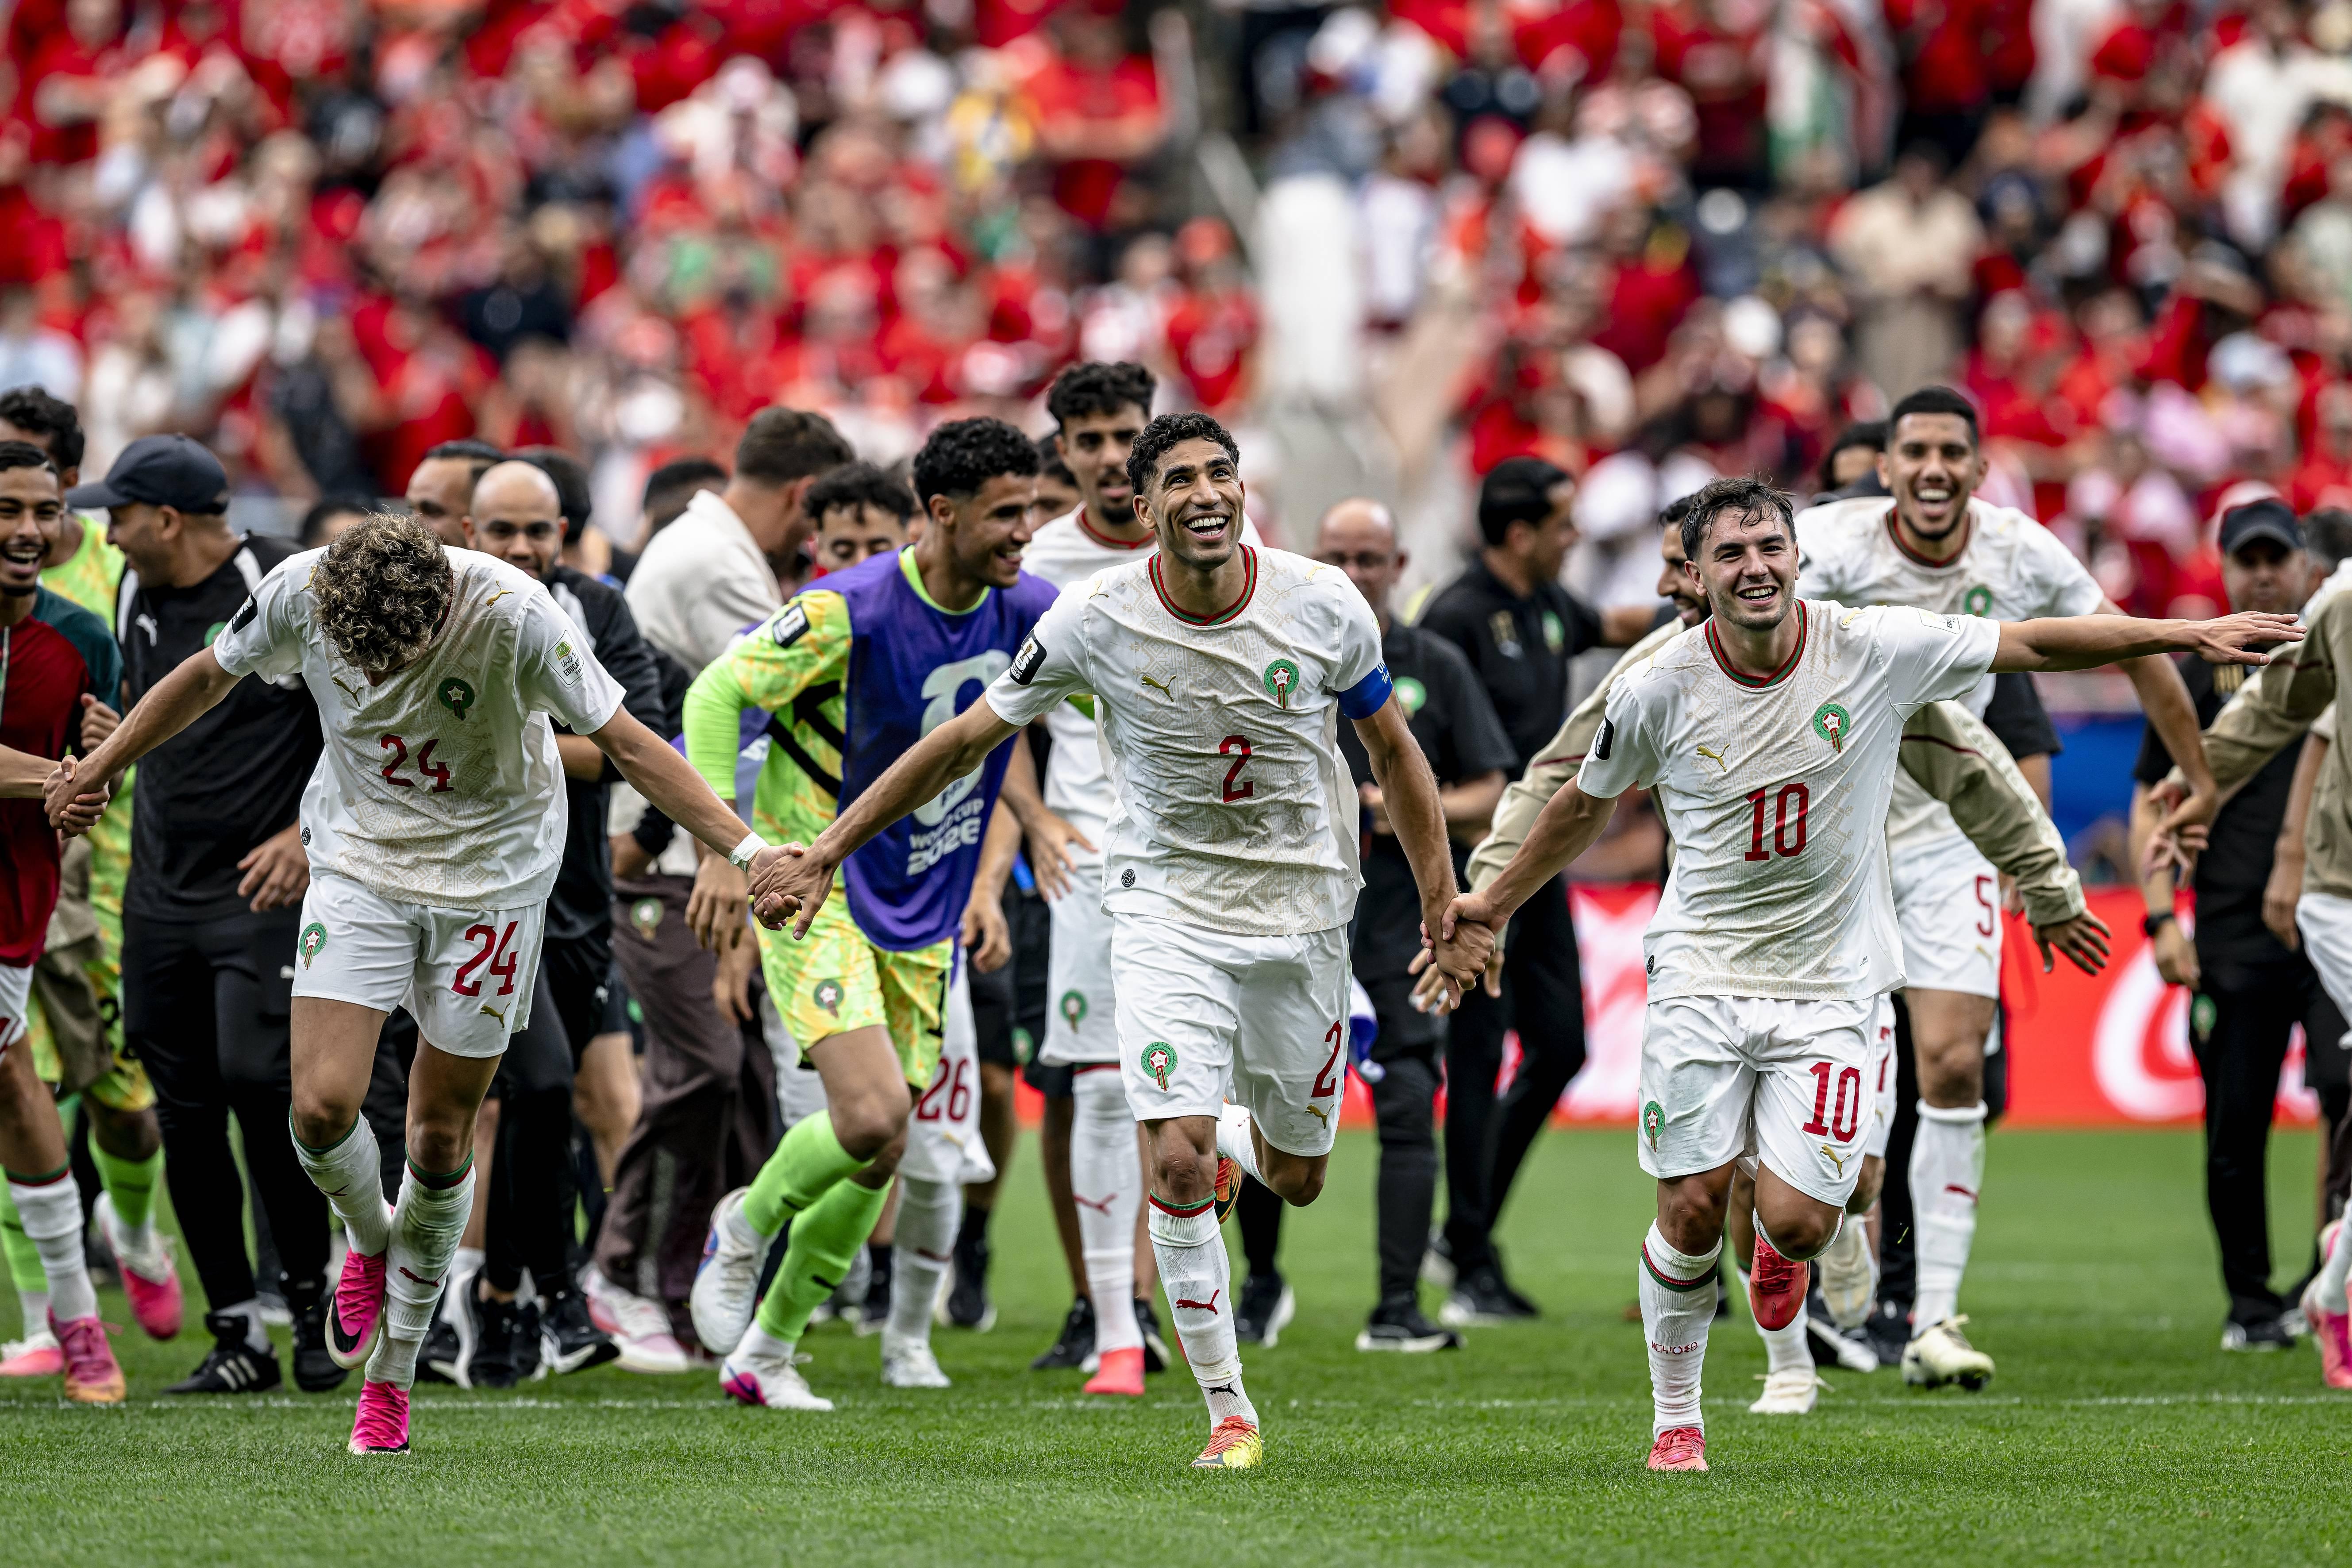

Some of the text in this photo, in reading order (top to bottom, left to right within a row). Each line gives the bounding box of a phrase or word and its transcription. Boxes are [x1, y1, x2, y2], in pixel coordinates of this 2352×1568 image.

[563, 657, 580, 677] EDUCAT
[381, 733, 454, 794] 24
[1219, 735, 1254, 804] 2
[1744, 782, 1809, 861] 10
[1976, 875, 1993, 937] 5
[450, 920, 519, 997] 24
[917, 1056, 970, 1122] 26
[1310, 1019, 1342, 1098] 2
[1802, 1062, 1860, 1143] 10
